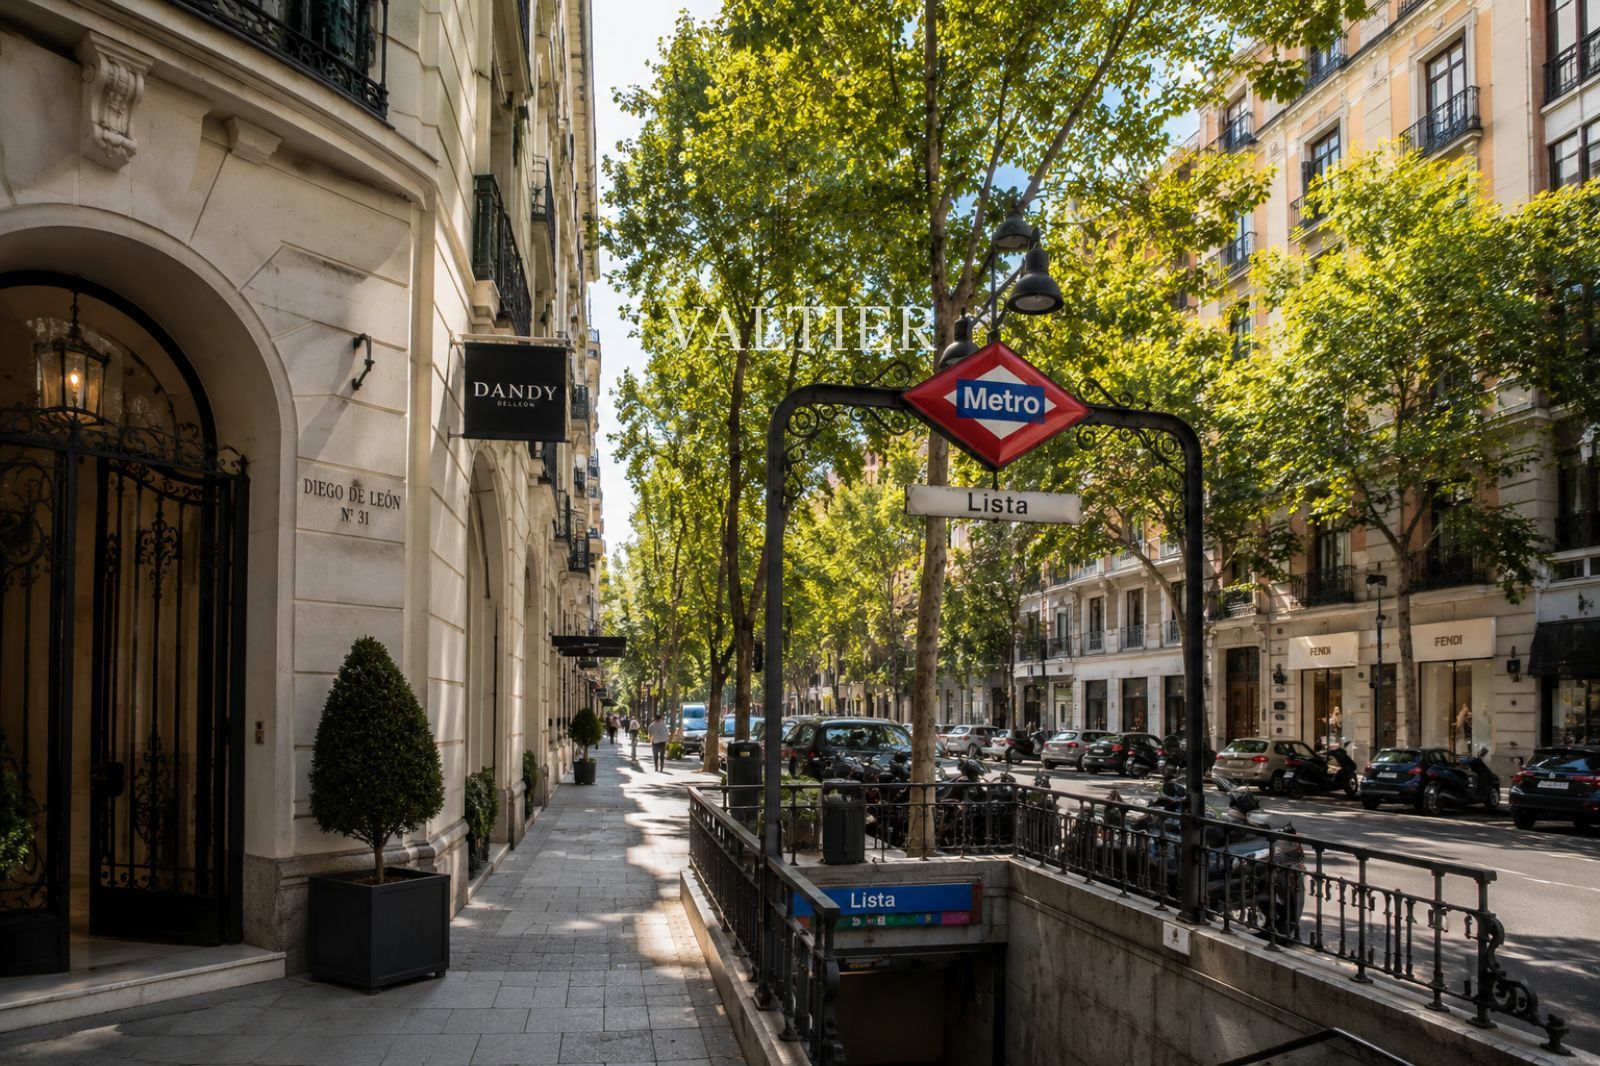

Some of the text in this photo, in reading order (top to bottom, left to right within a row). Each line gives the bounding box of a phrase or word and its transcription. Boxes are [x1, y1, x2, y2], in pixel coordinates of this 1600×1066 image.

[473, 381, 558, 400] DANDY
[964, 386, 1040, 414] Metro
[304, 478, 401, 510] DIEGO DE LEÓN
[968, 492, 1028, 514] Lista
[358, 510, 370, 525] 31
[1434, 634, 1463, 648] FENDI
[1309, 646, 1332, 657] FENDI
[850, 892, 896, 909] Lista
